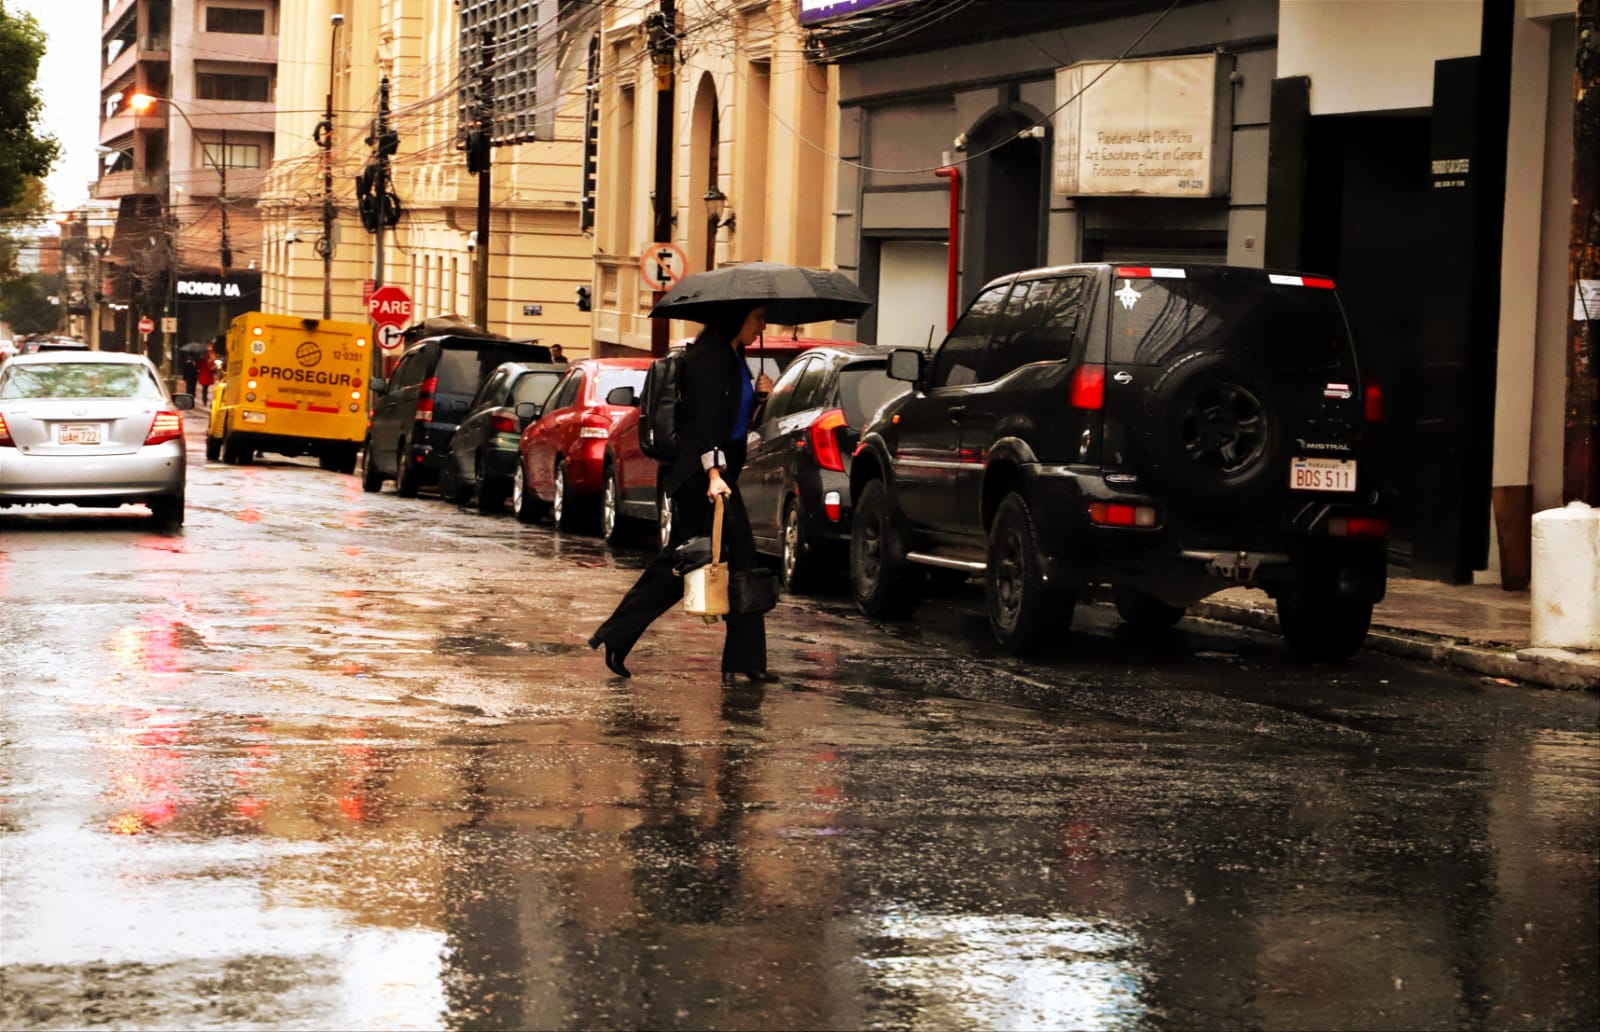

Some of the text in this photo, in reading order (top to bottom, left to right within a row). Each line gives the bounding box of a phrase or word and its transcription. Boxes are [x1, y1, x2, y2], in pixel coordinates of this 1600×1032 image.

[369, 299, 411, 315] PARE
[260, 365, 350, 387] PROSEGUR
[1296, 469, 1349, 489] BDS 511
